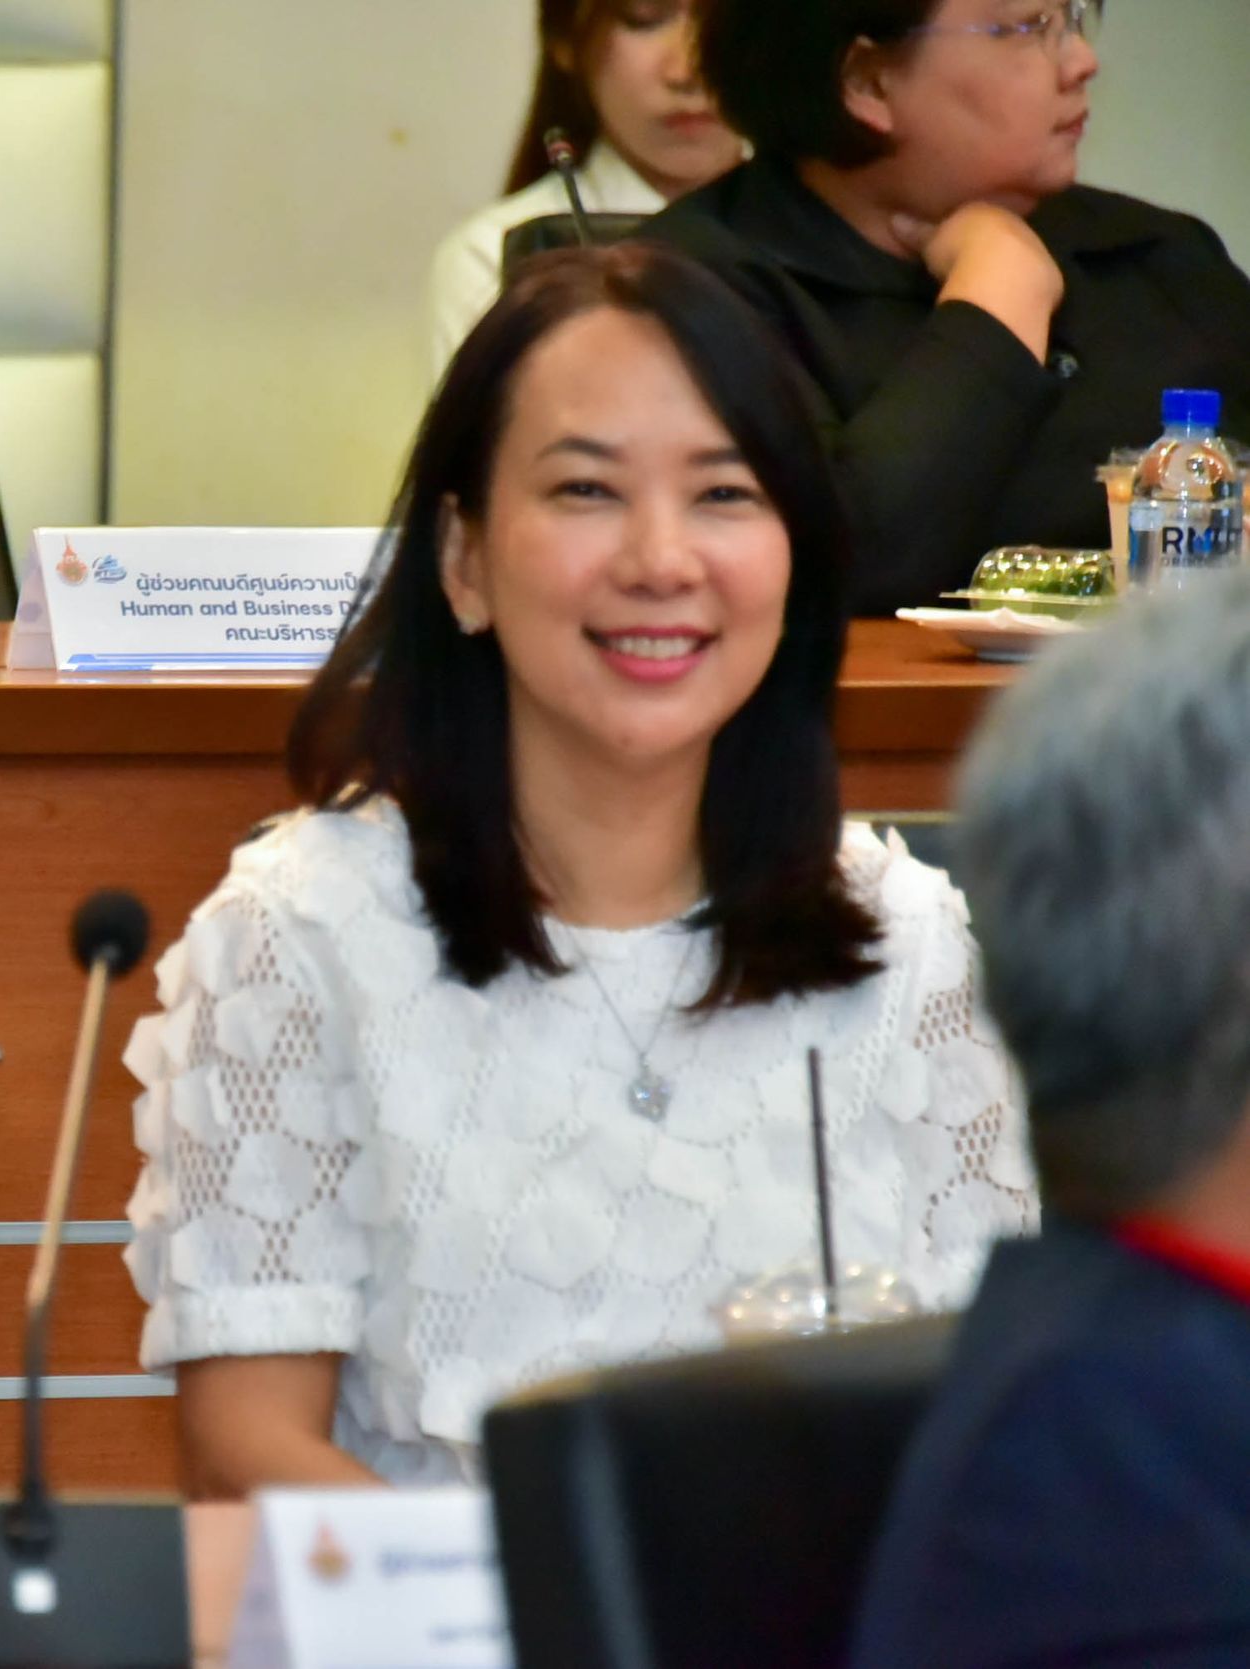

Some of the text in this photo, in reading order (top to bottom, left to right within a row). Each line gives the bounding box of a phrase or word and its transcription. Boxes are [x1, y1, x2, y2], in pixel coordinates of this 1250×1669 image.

[136, 571, 371, 597] ผู้ช่วยคณบดีศูนย์ความเป็
[120, 600, 194, 616] Human
[199, 600, 238, 616] and
[243, 600, 334, 616] Business
